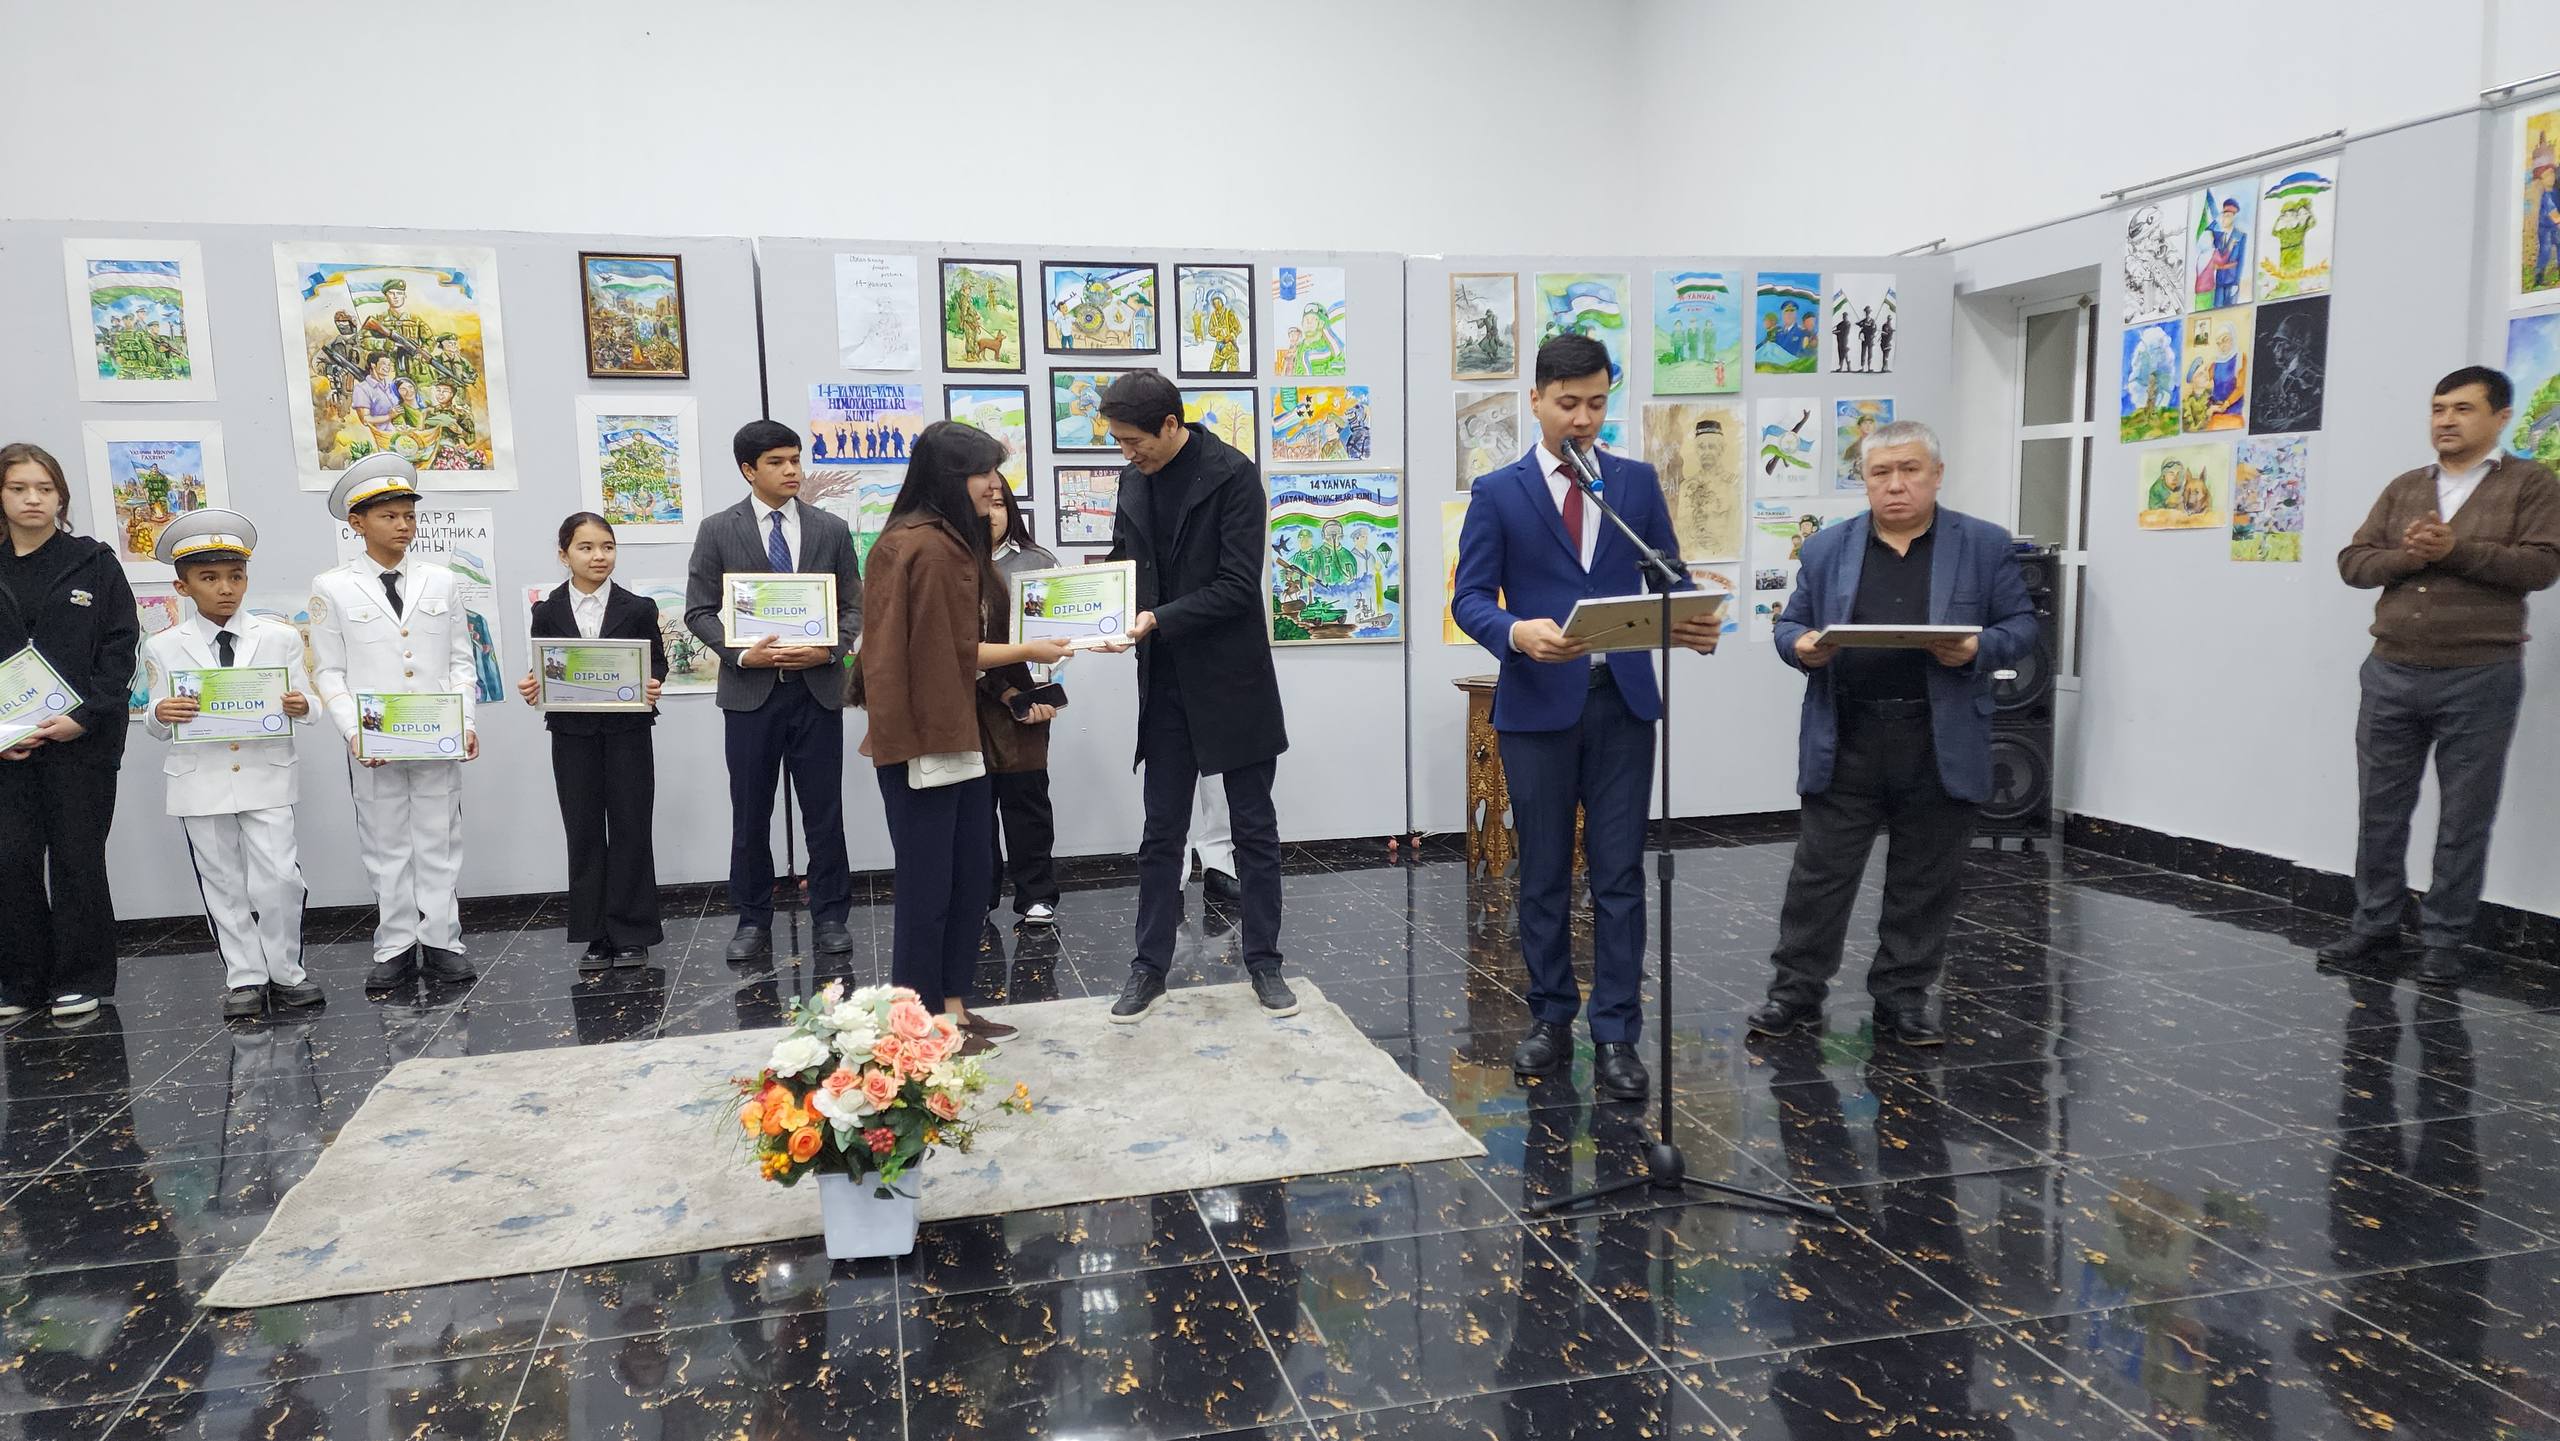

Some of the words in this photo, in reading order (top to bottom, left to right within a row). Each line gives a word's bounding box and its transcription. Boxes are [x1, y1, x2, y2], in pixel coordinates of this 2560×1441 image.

[845, 410, 875, 423] KUNI!
[1310, 480, 1320, 490] 14
[1322, 479, 1359, 489] YANVAR
[419, 512, 455, 524] АРЯ
[408, 540, 453, 553] ИНЫ!
[763, 607, 807, 615] DIPLOM
[1054, 602, 1101, 615] DIPLOM
[574, 672, 620, 680] DIPLOM
[0, 687, 38, 715] IPLOM
[211, 700, 264, 711] DIPLOM
[393, 723, 441, 732] DIPLOM
